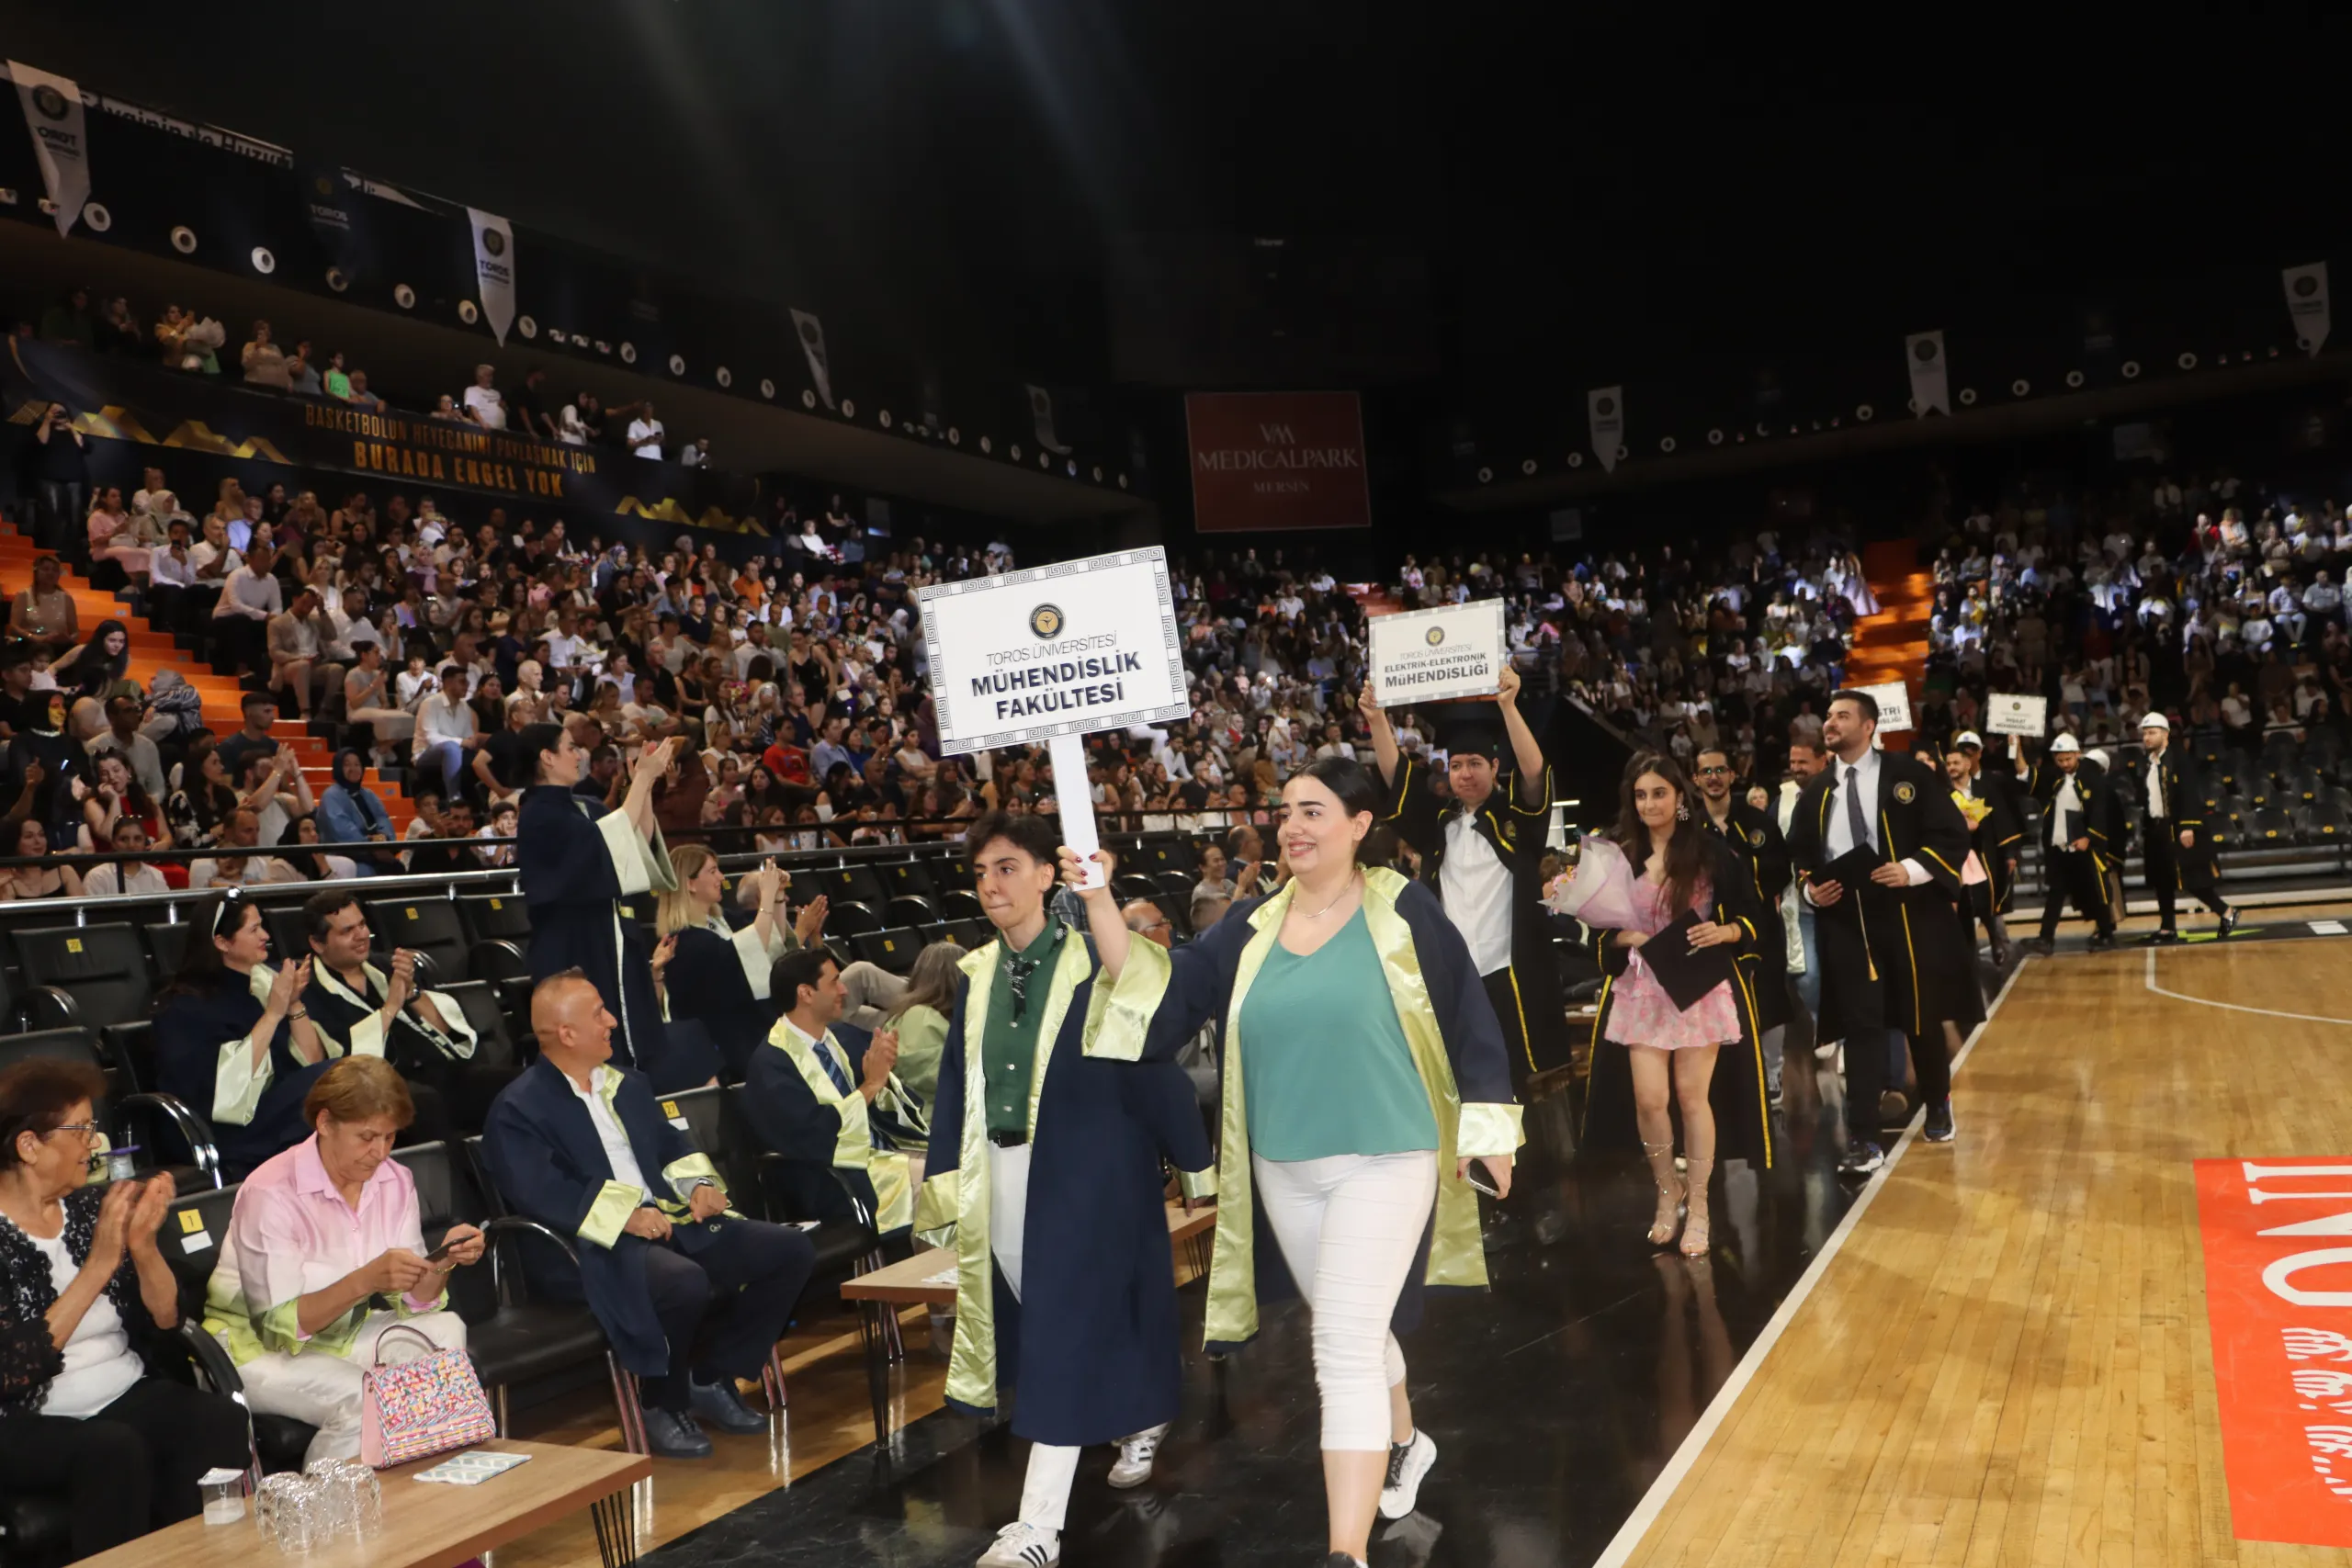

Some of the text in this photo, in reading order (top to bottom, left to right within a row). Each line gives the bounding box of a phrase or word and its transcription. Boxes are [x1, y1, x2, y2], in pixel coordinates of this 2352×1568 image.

[305, 403, 406, 441] BASKETBOLUN
[570, 450, 596, 475] İÇİN
[353, 441, 564, 498] BURADA ENGEL YOK
[986, 629, 1118, 666] TOROS ÜNİVERSİTESİ
[971, 649, 1143, 697] MÜHENDİSLİK
[996, 676, 1125, 720] FAKÜLTESİ
[187, 1215, 195, 1228] 1
